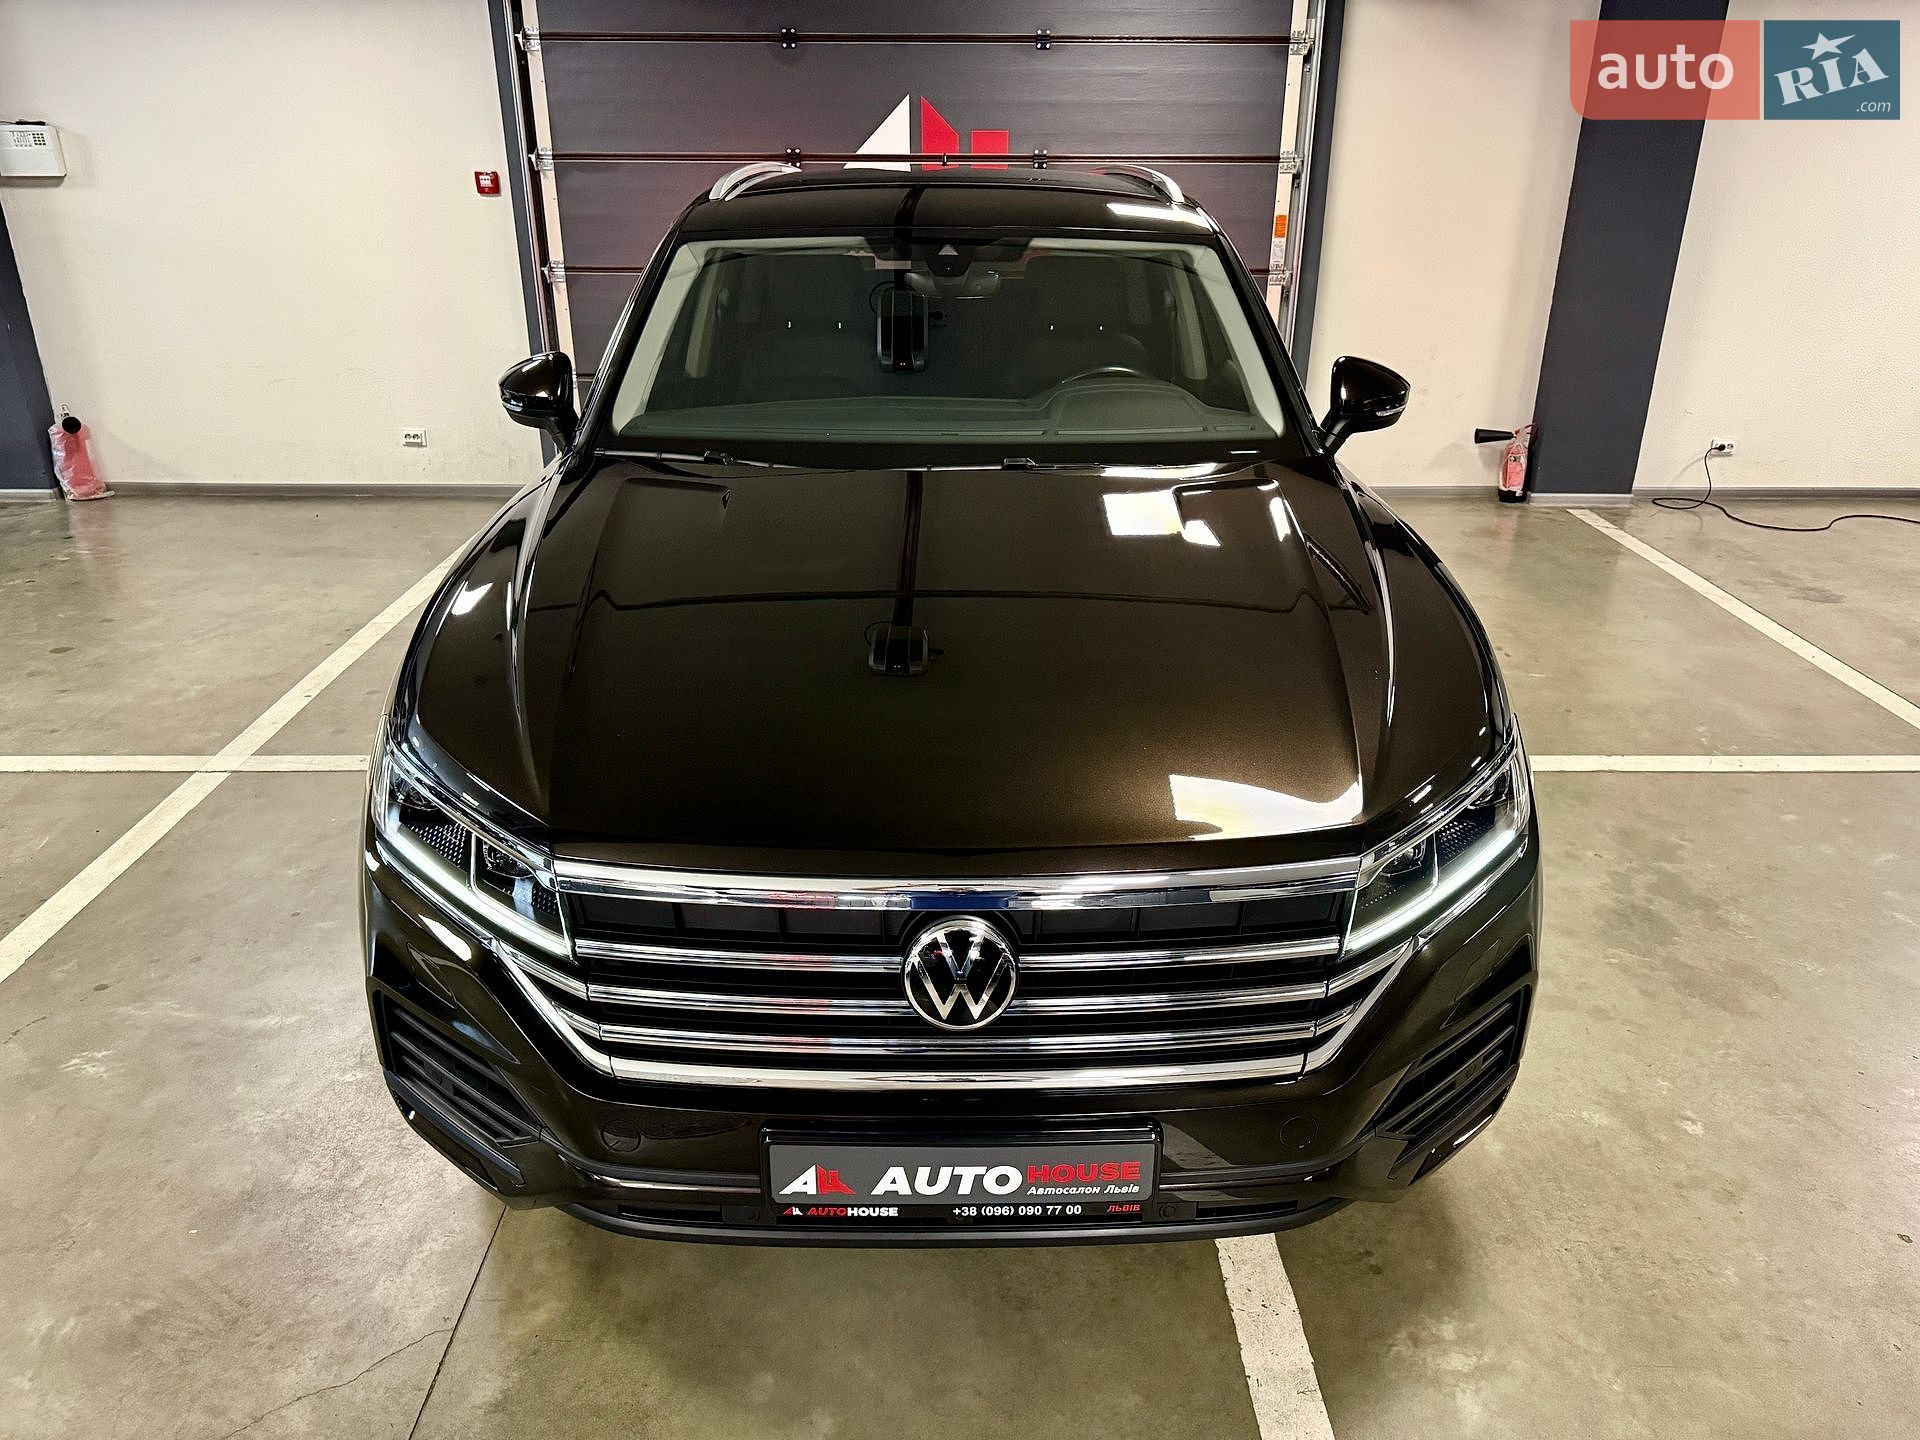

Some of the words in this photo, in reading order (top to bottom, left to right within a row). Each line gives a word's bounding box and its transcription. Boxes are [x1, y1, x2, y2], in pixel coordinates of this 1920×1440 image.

[1026, 1186, 1101, 1196] Автосалон
[1103, 1183, 1140, 1195] Львів
[952, 1206, 978, 1217] +38
[981, 1205, 1015, 1216] (096)
[1018, 1205, 1042, 1216] 090
[1046, 1205, 1062, 1215] 77
[1065, 1204, 1082, 1215] 00
[1106, 1203, 1141, 1213] ЛЬВІВ
